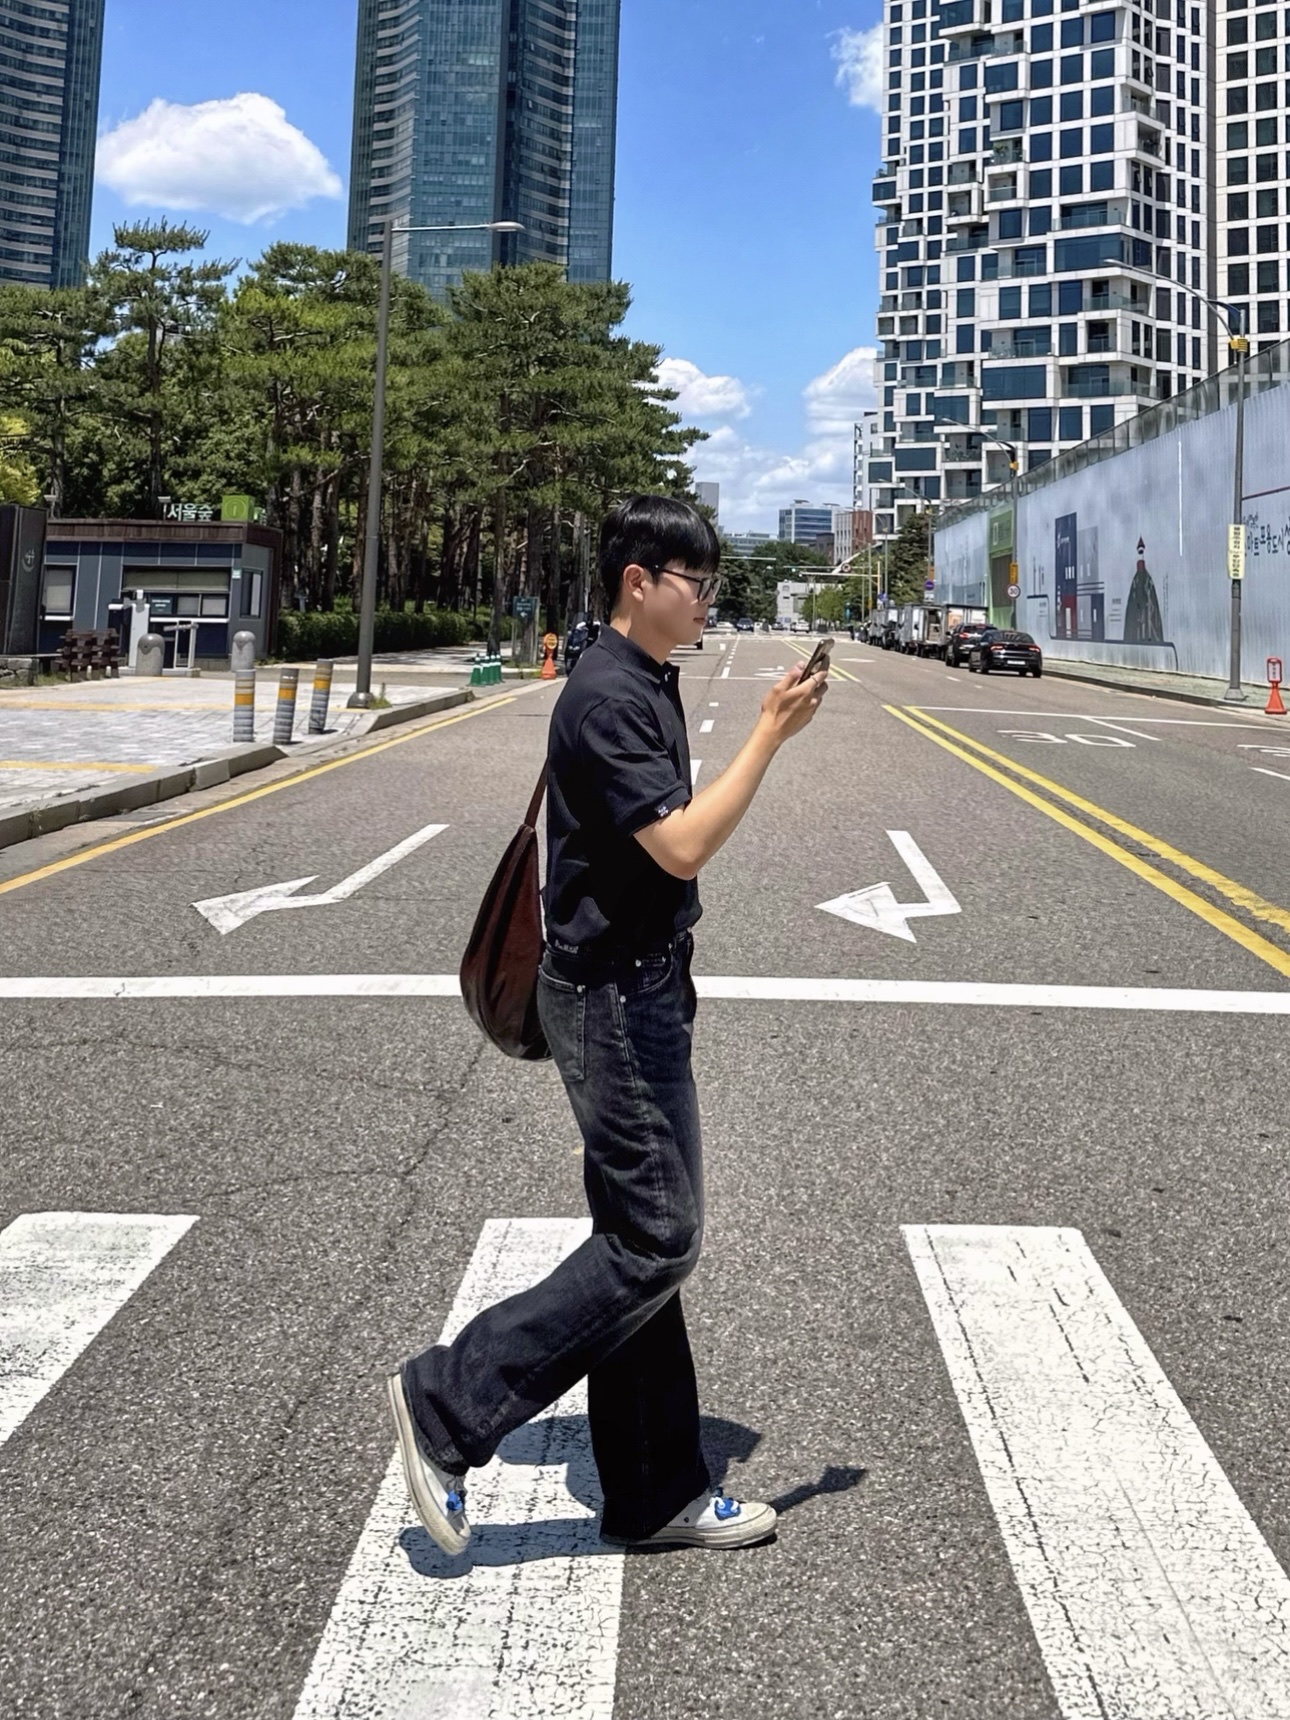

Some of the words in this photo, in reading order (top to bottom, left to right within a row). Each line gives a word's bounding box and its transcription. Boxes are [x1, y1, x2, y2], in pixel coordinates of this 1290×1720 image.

[167, 503, 213, 521] 서울숲
[1244, 523, 1284, 557] 마트포용도시
[1009, 587, 1018, 595] 30
[996, 730, 1136, 748] 30
[1237, 744, 1290, 758] 3
